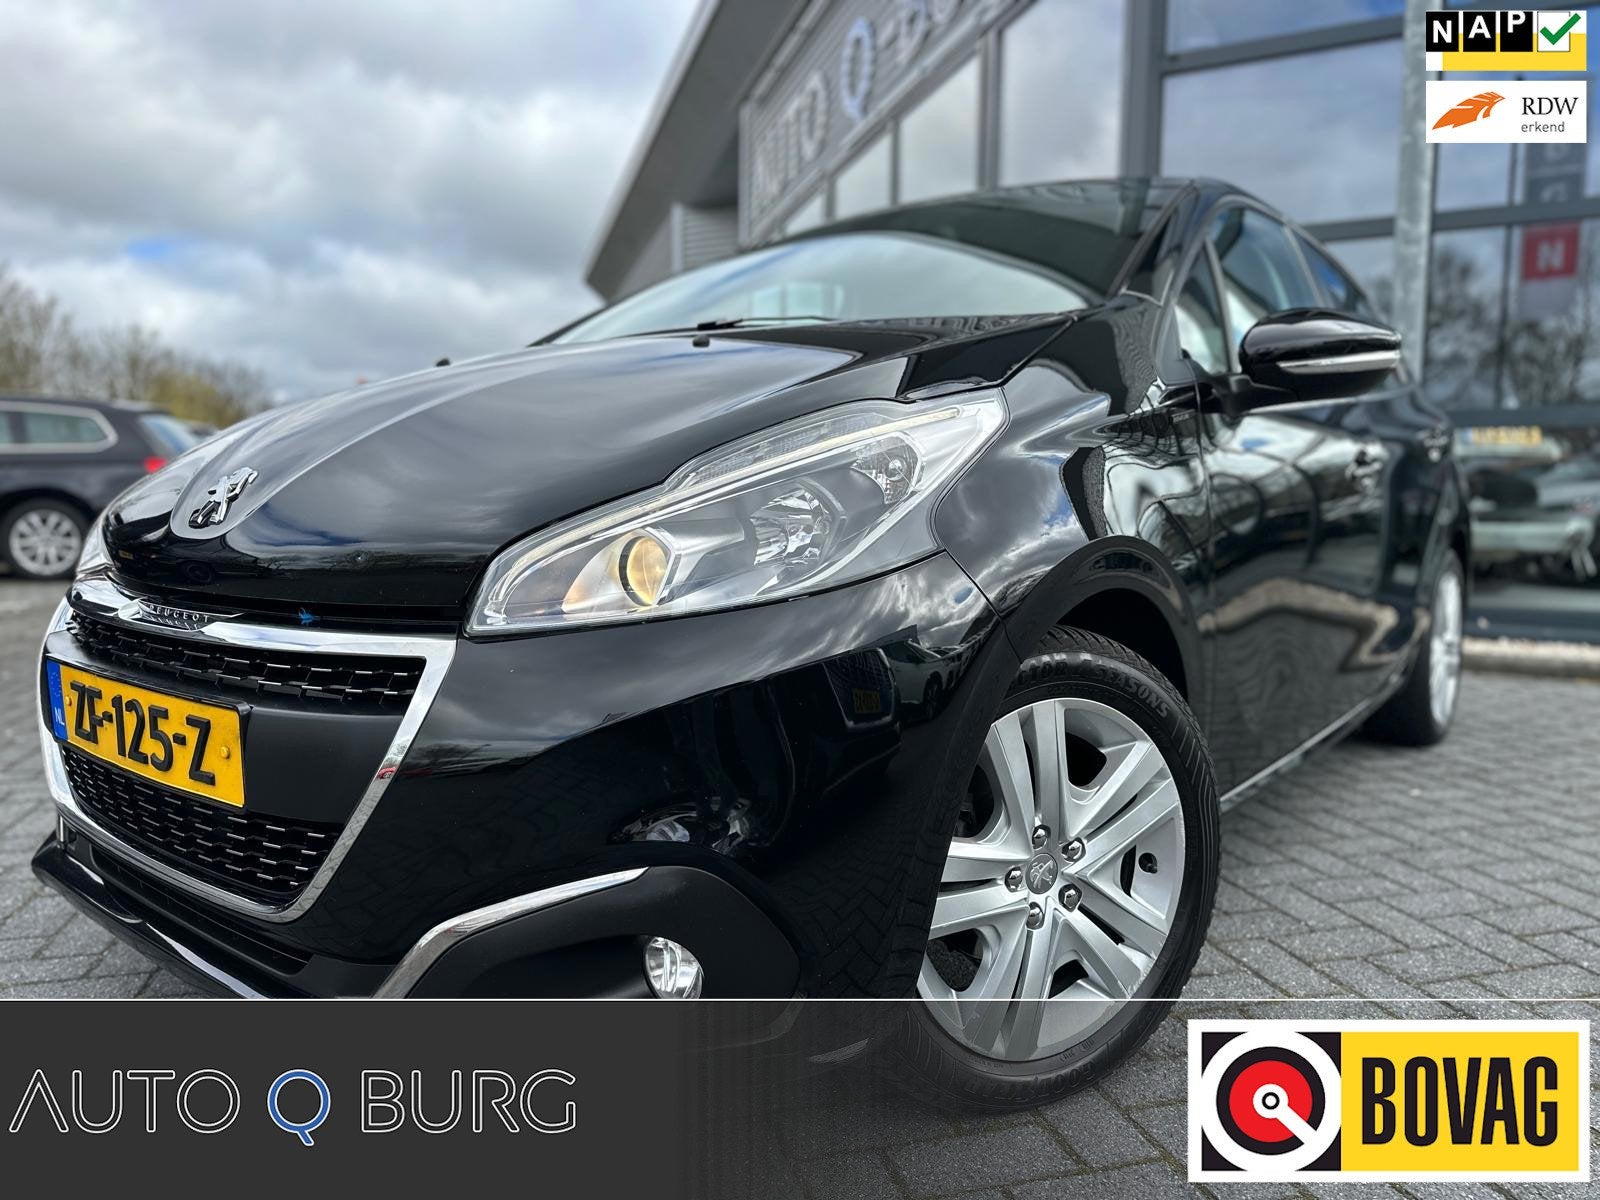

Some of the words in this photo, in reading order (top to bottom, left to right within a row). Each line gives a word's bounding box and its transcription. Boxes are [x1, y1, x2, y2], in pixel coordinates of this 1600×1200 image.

[149, 604, 209, 623] PEUGEOT
[54, 706, 66, 726] NL
[70, 680, 216, 786] ZF-125-Z
